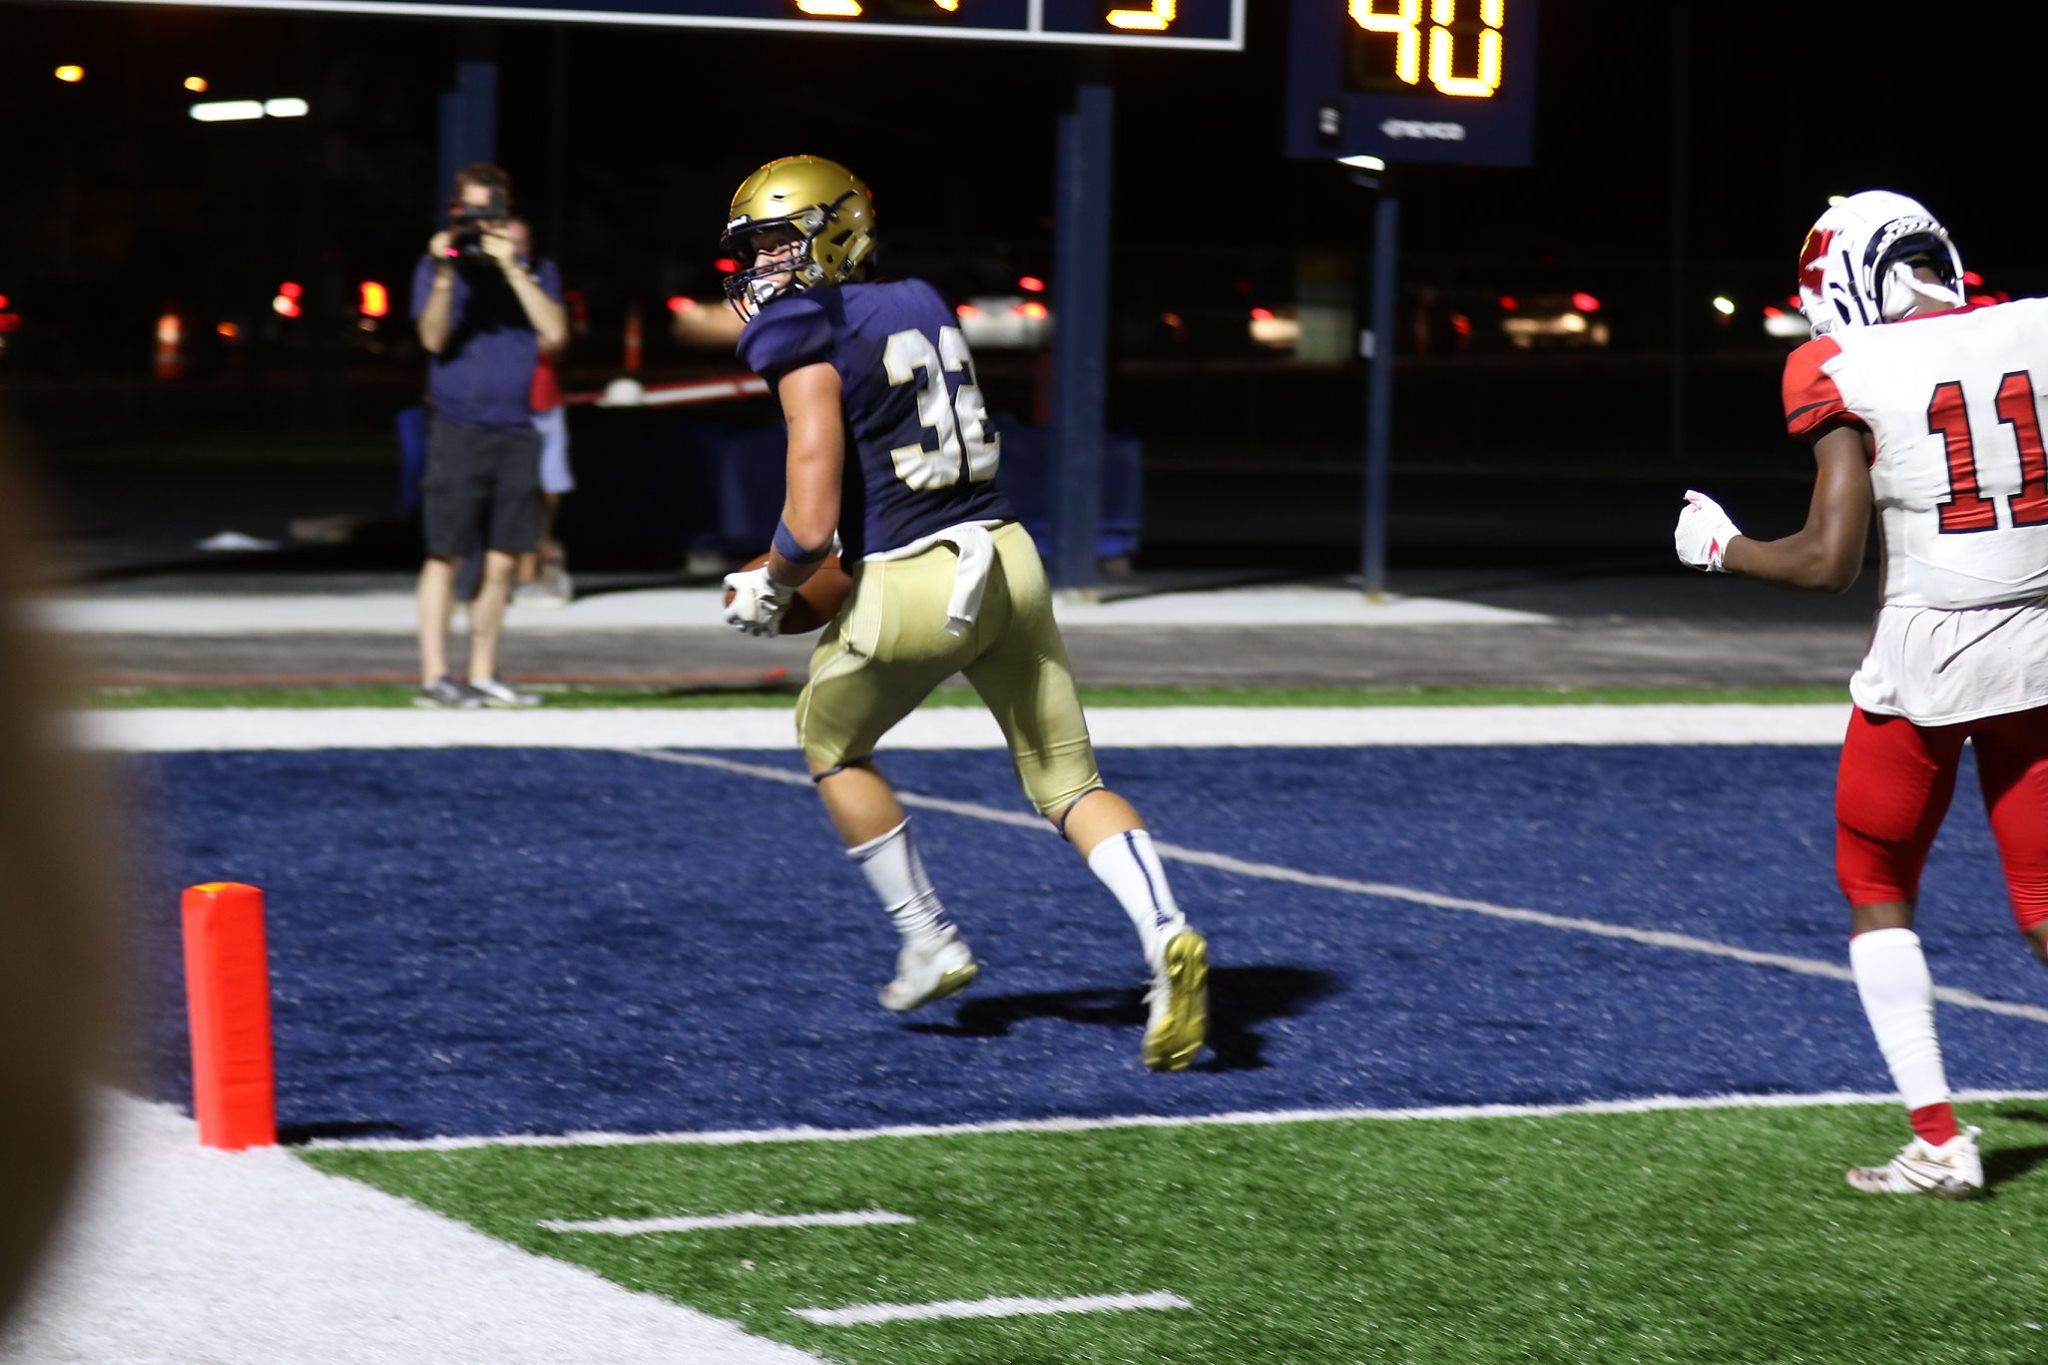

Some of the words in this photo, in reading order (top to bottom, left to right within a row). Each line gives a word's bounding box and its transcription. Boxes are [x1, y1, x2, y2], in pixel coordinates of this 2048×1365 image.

[1347, 0, 1504, 97] 40
[884, 326, 1001, 491] 32
[1927, 370, 2048, 534] 11
